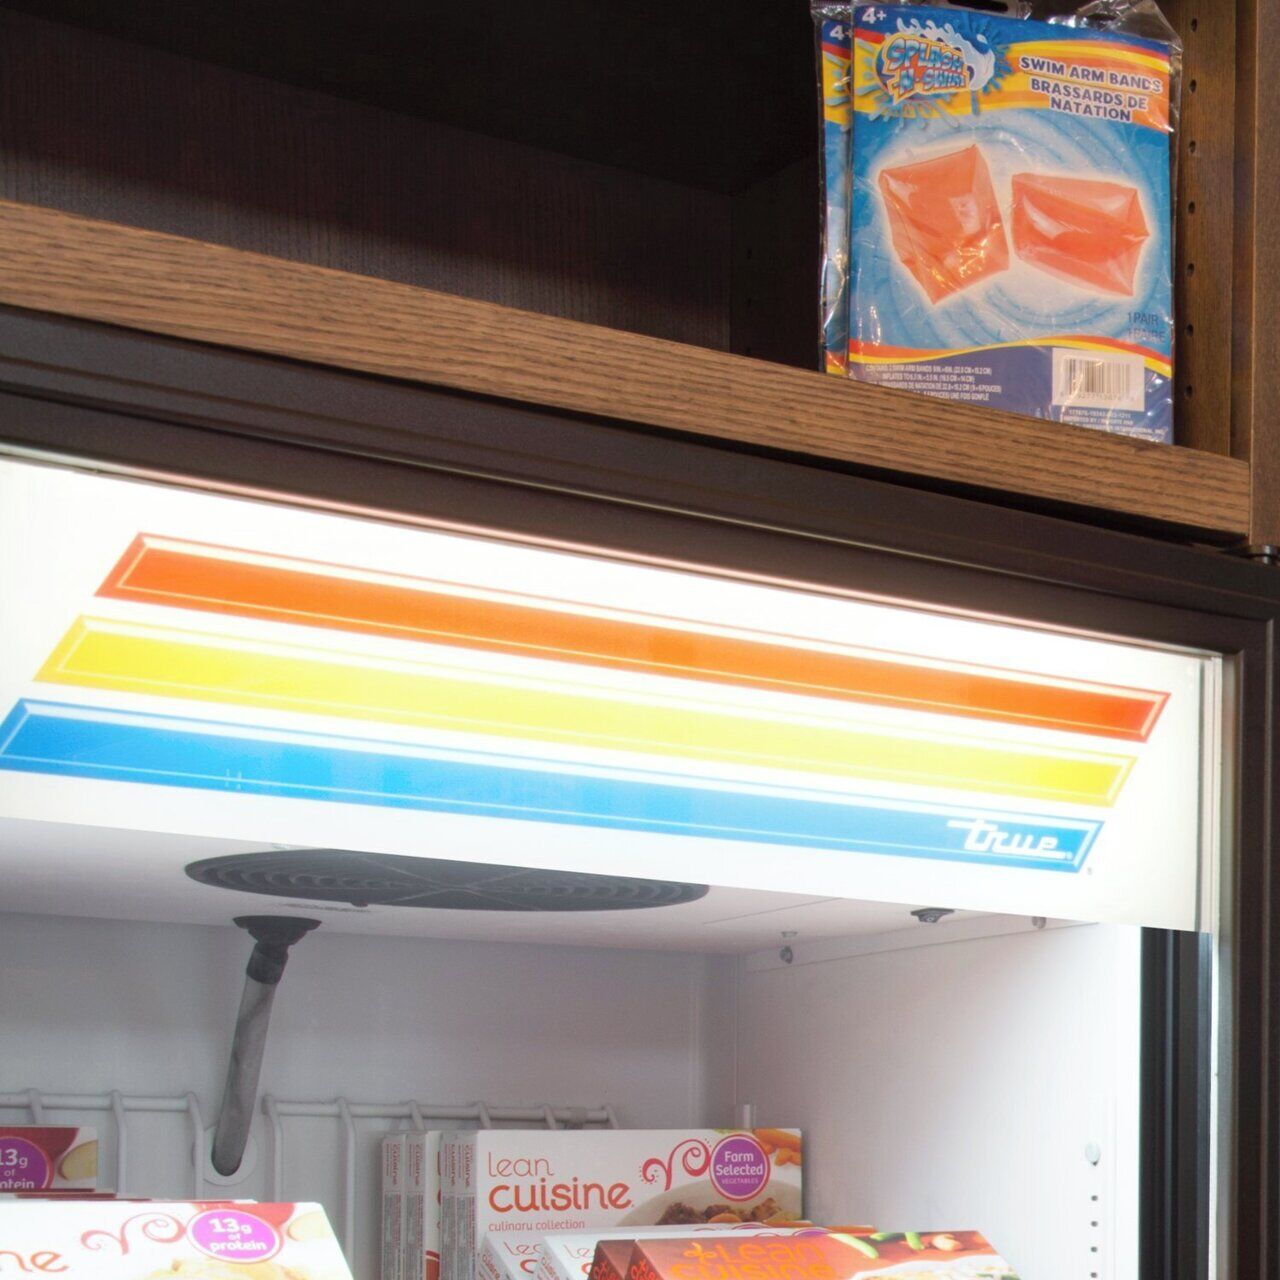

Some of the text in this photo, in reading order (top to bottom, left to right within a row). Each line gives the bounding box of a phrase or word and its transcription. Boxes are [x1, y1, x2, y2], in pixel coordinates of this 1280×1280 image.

[861, 6, 887, 24] 4+
[887, 39, 964, 71] SPLASH
[1019, 55, 1162, 93] SWIM ARM BANDS
[1030, 78, 1149, 110] BRASSARDS DE
[1050, 96, 1132, 122] NATATION
[1133, 312, 1159, 325] PAIR
[488, 1152, 555, 1178] lean
[724, 1150, 755, 1163] Farm
[715, 1162, 765, 1177] Selected
[488, 1175, 631, 1213] cuisine
[209, 1217, 252, 1236] 13g
[488, 1217, 586, 1234] culinary collection
[208, 1240, 268, 1254] protein
